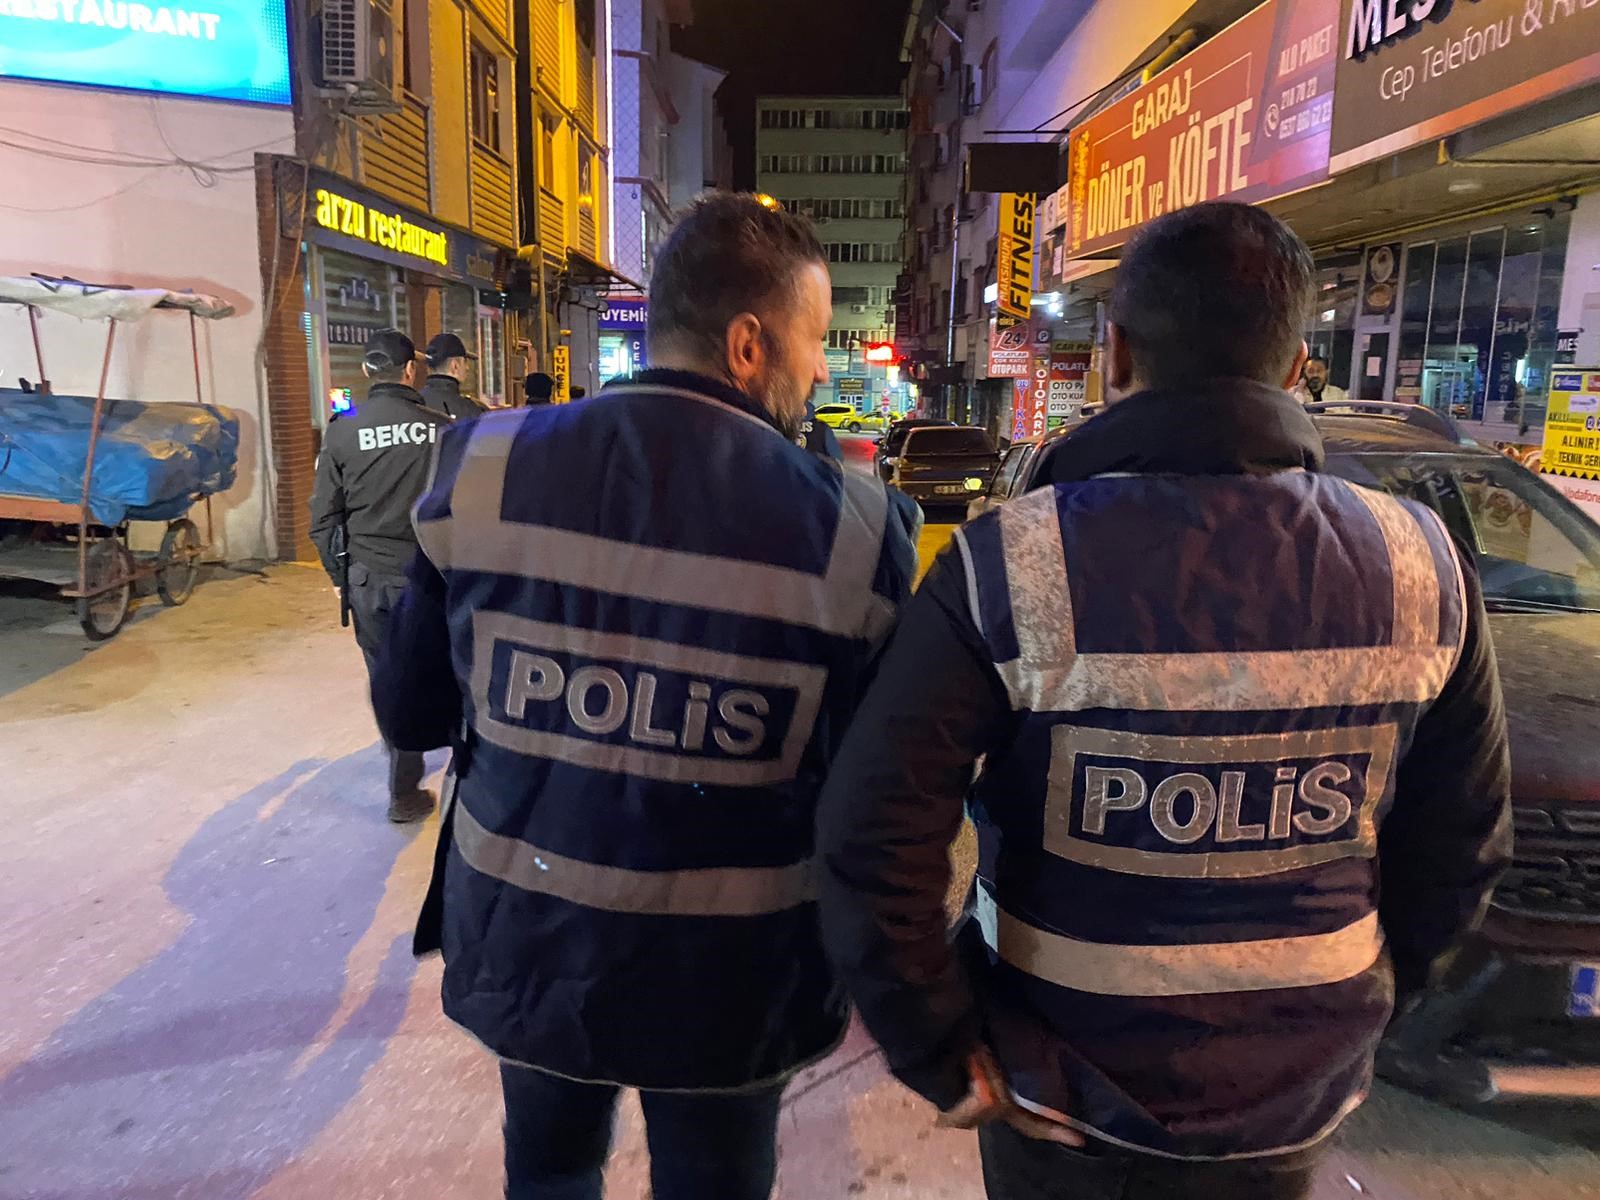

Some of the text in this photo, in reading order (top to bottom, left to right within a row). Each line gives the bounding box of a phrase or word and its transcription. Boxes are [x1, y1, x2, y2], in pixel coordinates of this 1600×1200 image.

[1299, 25, 1333, 67] PAKET
[1379, 65, 1415, 101] Cep
[1421, 15, 1513, 82] Telefonu
[1521, 0, 1543, 36] &
[1131, 67, 1193, 140] GARAJ
[1086, 155, 1147, 240] DÖNER
[1167, 98, 1254, 212] KÖFTE
[316, 189, 448, 266] arzu restaurant
[598, 307, 648, 322] UYEMİ
[992, 364, 1028, 375] OTOPARK
[1053, 382, 1073, 390] OTO
